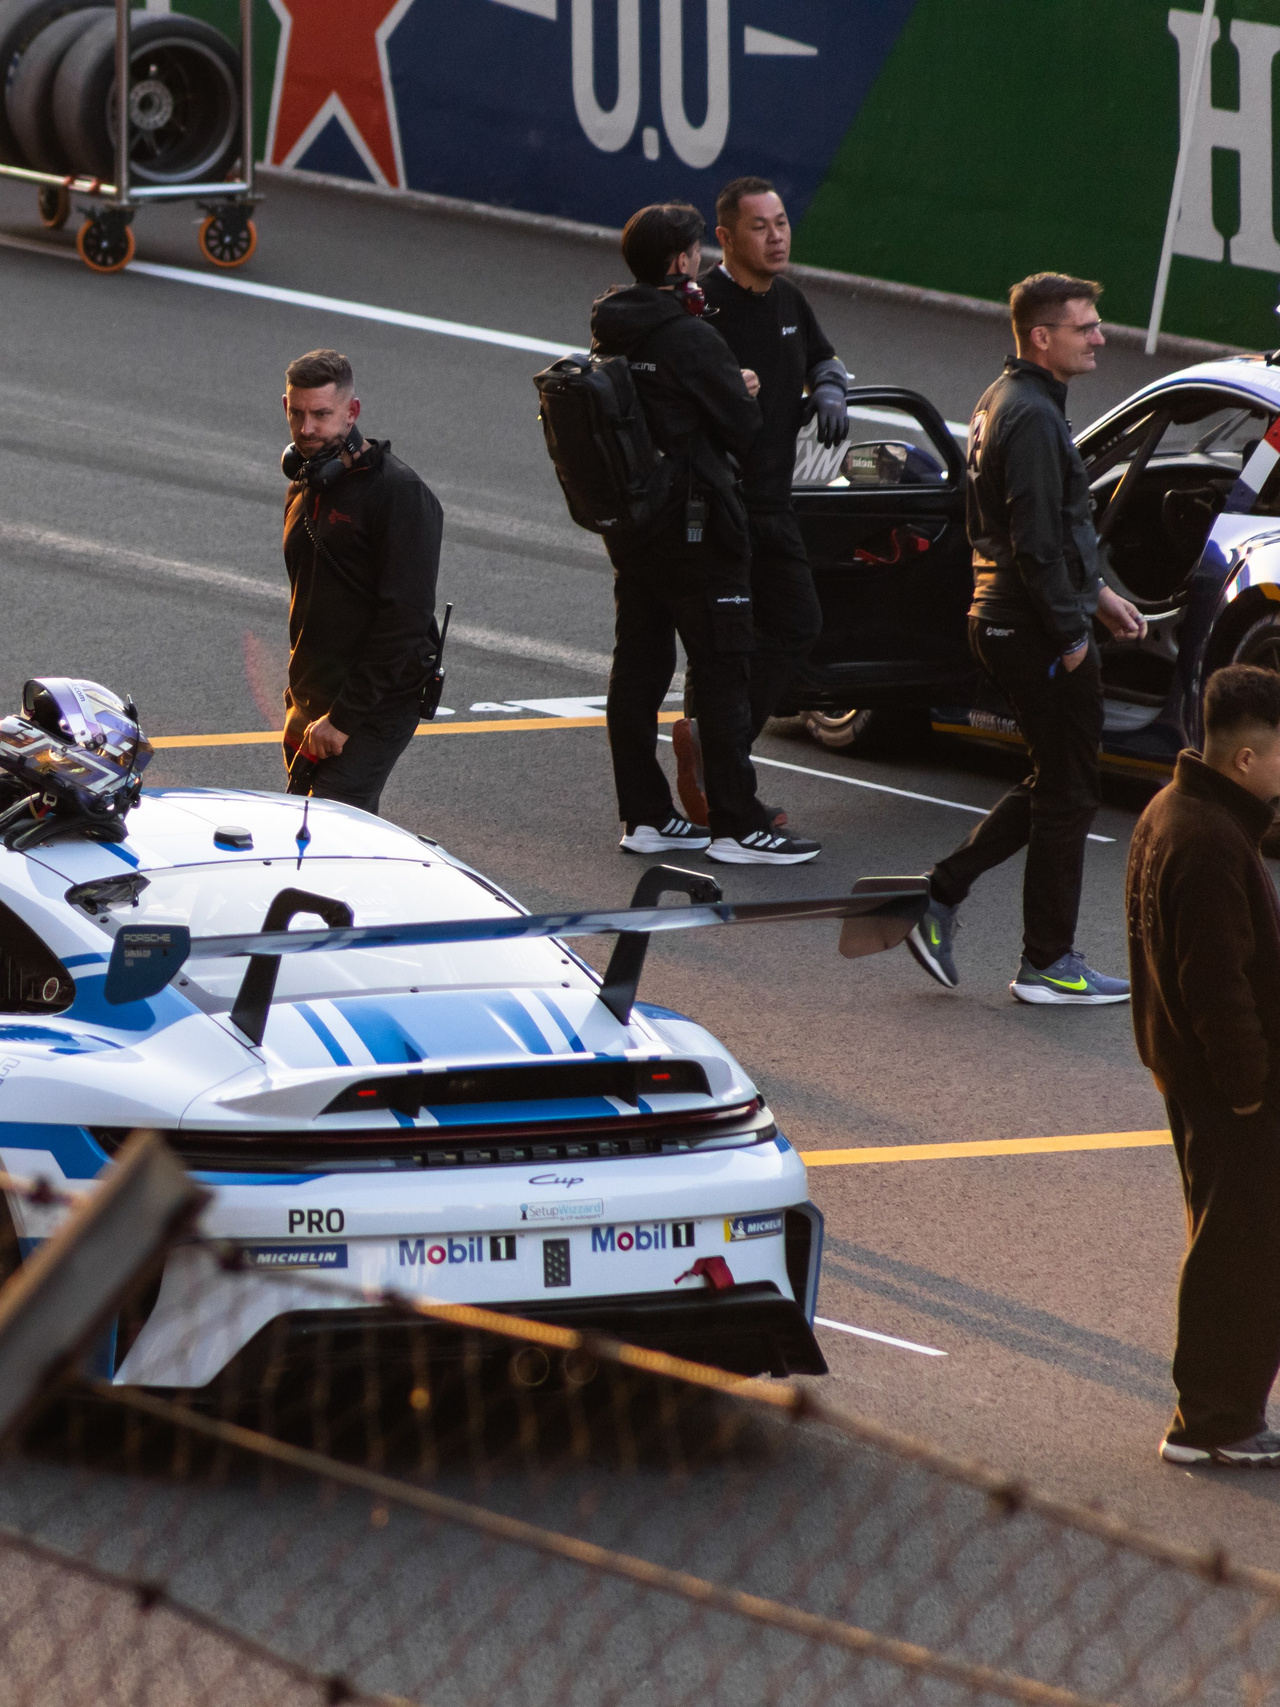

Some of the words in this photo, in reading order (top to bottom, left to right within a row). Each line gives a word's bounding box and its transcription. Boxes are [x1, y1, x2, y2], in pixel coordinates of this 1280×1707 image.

[123, 933, 171, 943] PORSCHE
[528, 1173, 584, 1189] Cup
[529, 1202, 601, 1217] SetupWizzard
[288, 1207, 345, 1234] PRO
[591, 1223, 667, 1253] Mobil
[256, 1251, 337, 1264] MICHELIN
[399, 1236, 483, 1266] Mobil
